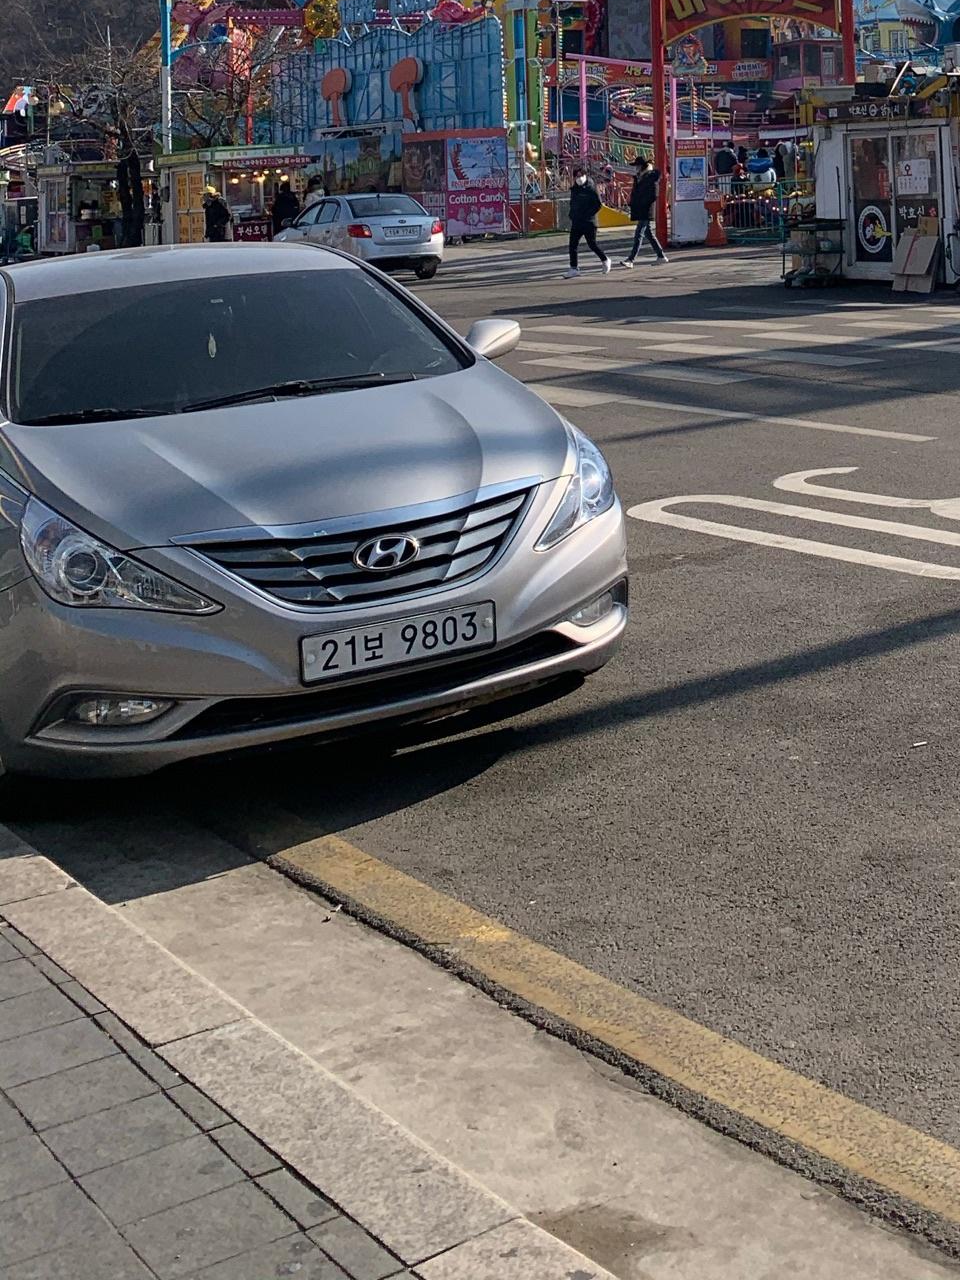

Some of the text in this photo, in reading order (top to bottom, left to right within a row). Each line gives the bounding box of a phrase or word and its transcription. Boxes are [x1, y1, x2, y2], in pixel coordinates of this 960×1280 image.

[449, 194, 477, 205] Cotton
[898, 205, 925, 220] 박효신
[321, 612, 478, 671] 21보 9803
